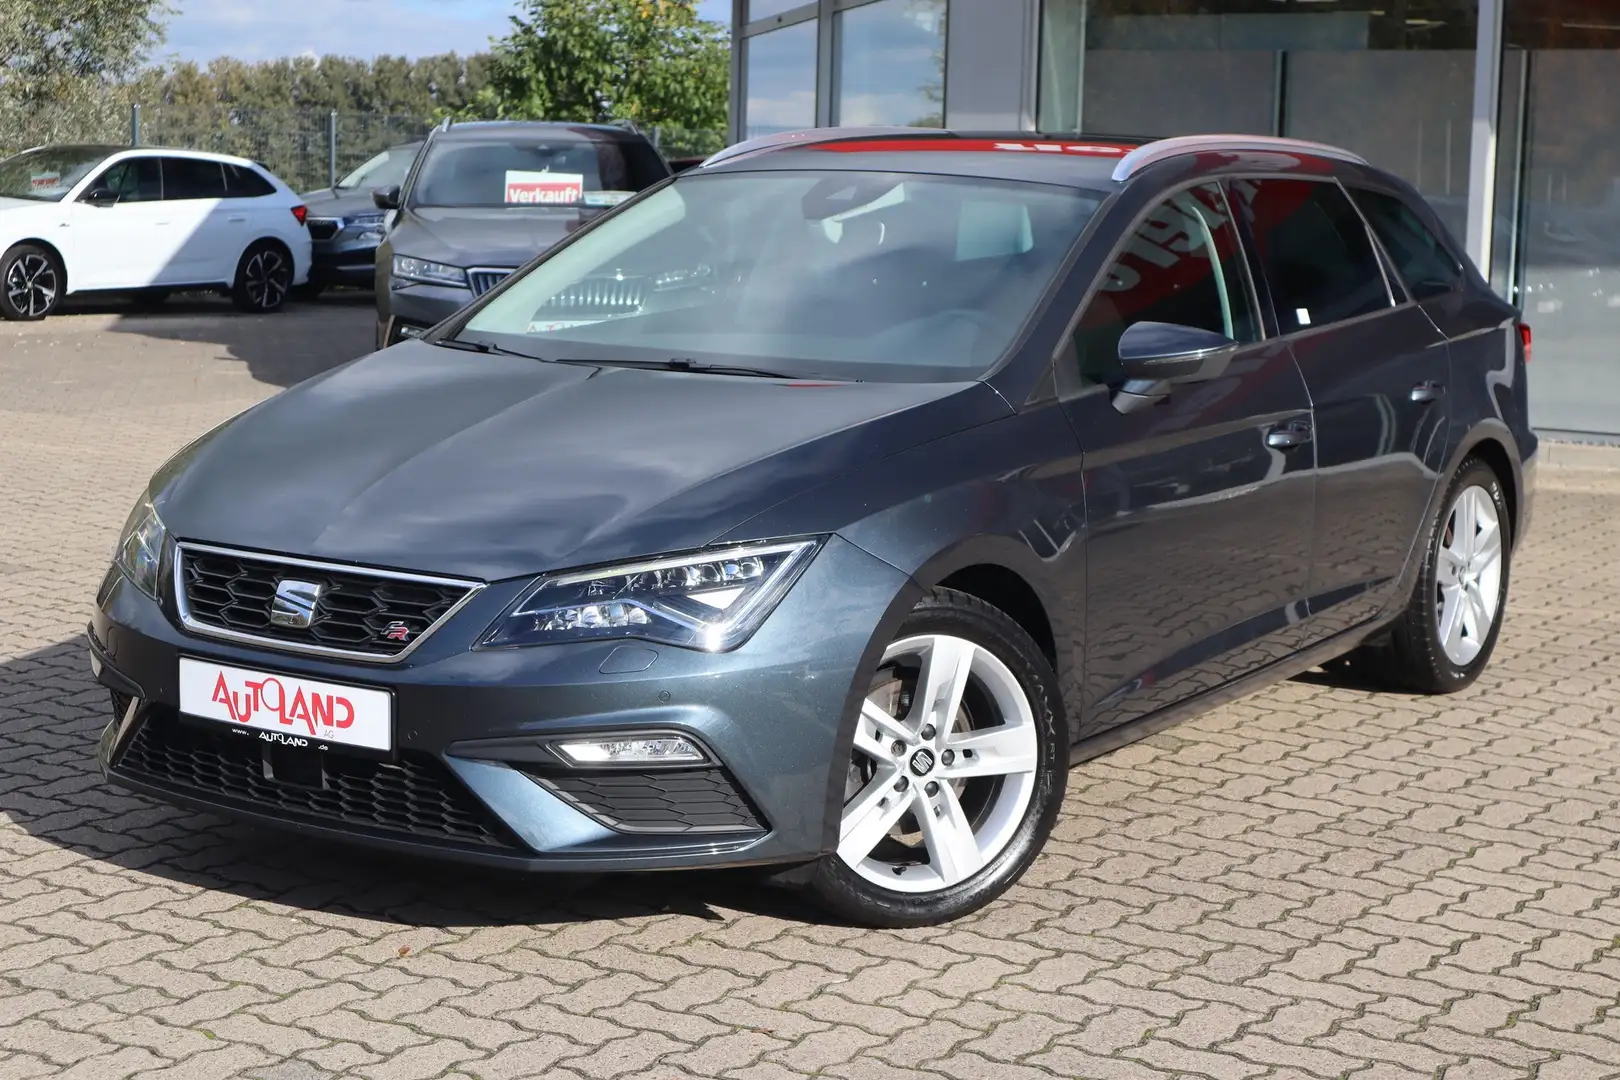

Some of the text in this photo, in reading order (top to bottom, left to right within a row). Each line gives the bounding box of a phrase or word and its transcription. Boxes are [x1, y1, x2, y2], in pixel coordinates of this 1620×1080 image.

[509, 187, 578, 203] Verkauft
[380, 620, 410, 642] FR
[323, 729, 335, 739] AG
